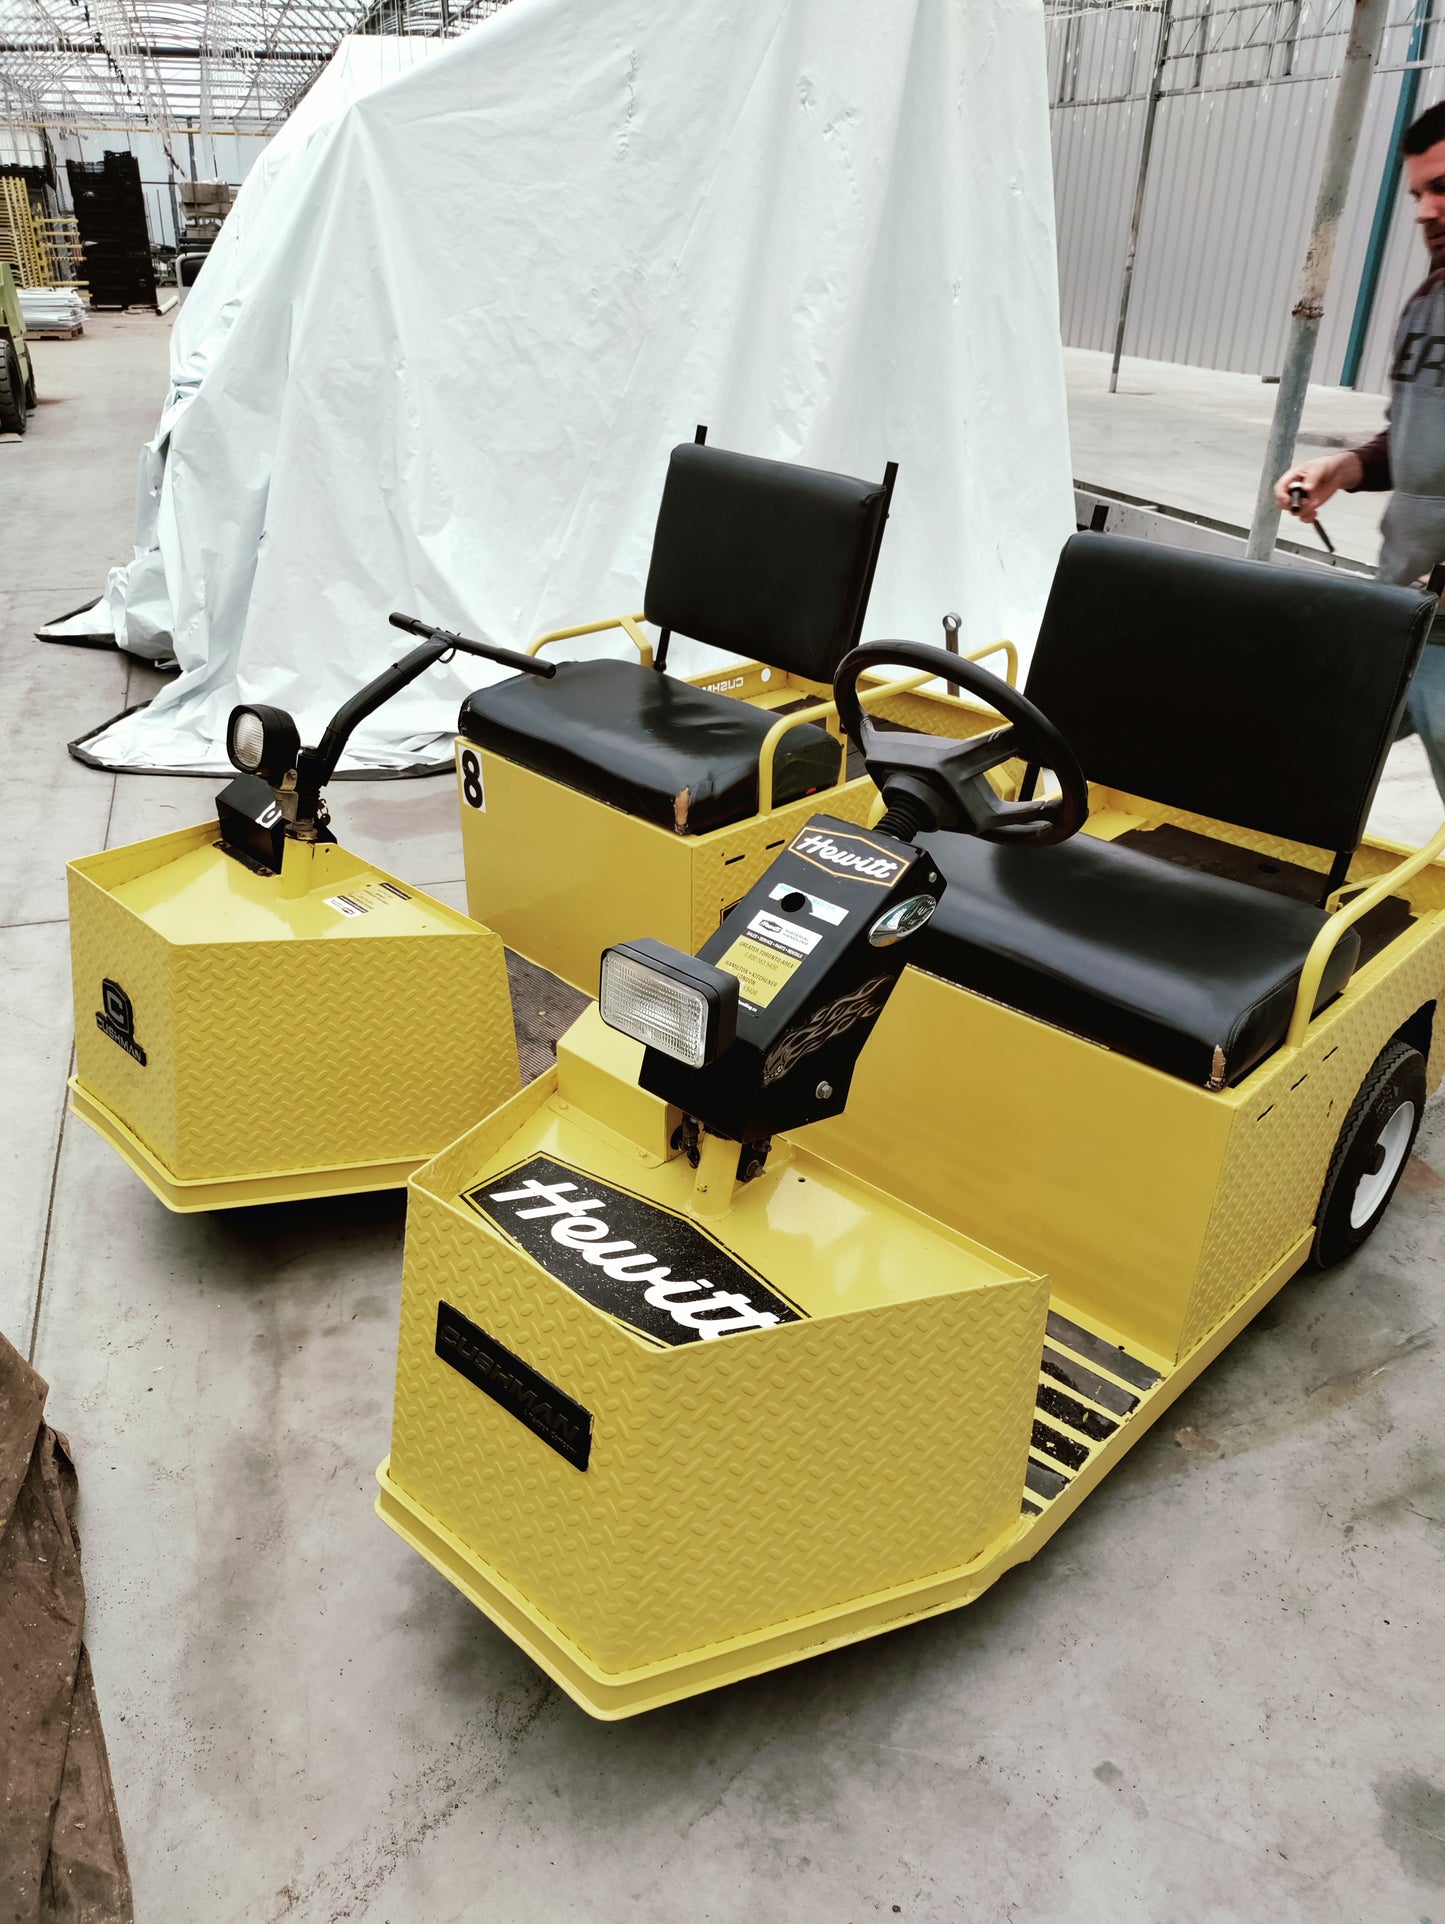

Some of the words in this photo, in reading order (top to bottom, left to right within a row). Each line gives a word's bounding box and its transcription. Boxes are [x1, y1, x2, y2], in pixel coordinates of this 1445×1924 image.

[462, 749, 483, 809] 8
[796, 835, 898, 879] Hewitt
[782, 933, 809, 946] HANDLING
[785, 929, 809, 941] MATERIAL
[739, 941, 759, 953] GREATER
[760, 950, 781, 962] TORONTO
[780, 959, 794, 969] AREA
[725, 960, 748, 974] HAMILTON
[752, 972, 778, 987] KITCHENER
[737, 973, 756, 986] LONDON
[97, 1015, 142, 1062] CUSHMAN
[489, 1178, 780, 1341] Hewitt
[440, 1324, 580, 1442] CUSHMAN
